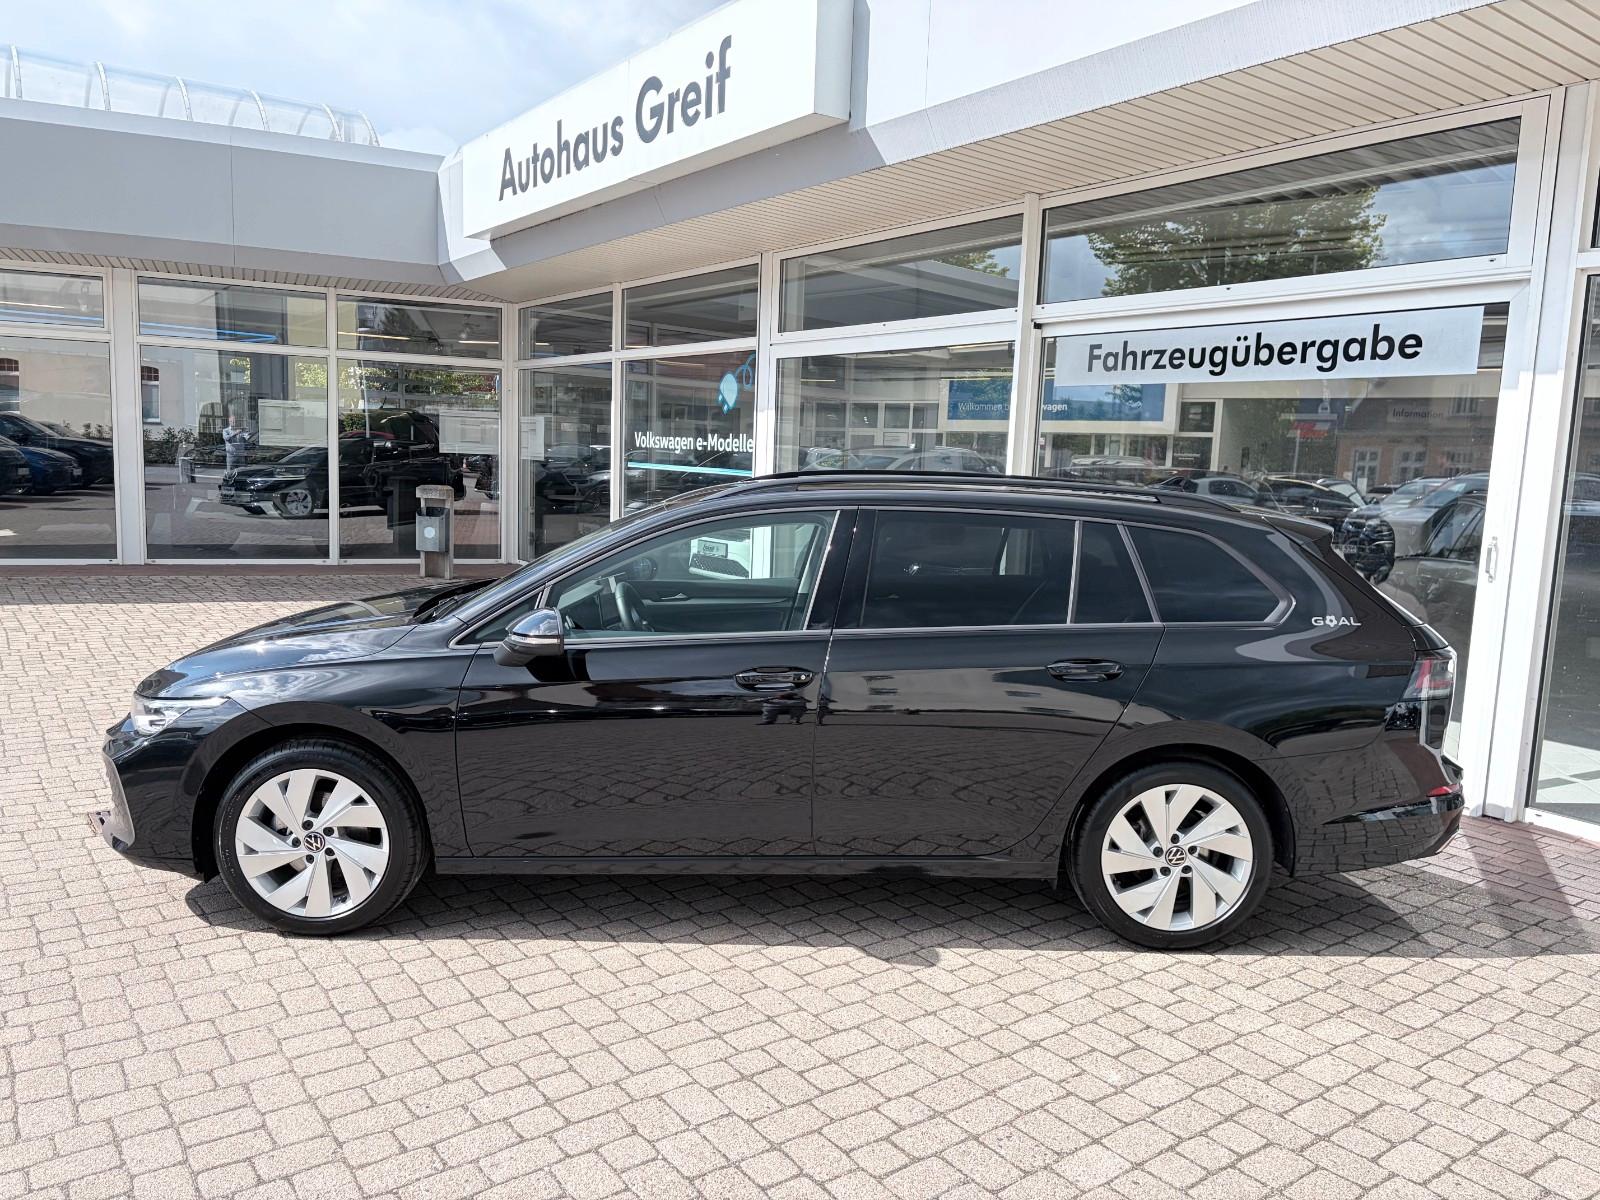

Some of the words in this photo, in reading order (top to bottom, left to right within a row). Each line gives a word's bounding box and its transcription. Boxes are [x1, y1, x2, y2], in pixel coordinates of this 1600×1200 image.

[499, 115, 624, 201] Autohaus
[635, 35, 732, 144] Greif
[1087, 323, 1424, 377] Fahrzeugübergabe
[958, 401, 1003, 412] Willkommen
[634, 431, 694, 454] Volkswagen
[696, 433, 754, 453] e-Modelle
[1311, 615, 1362, 628] GOAL
